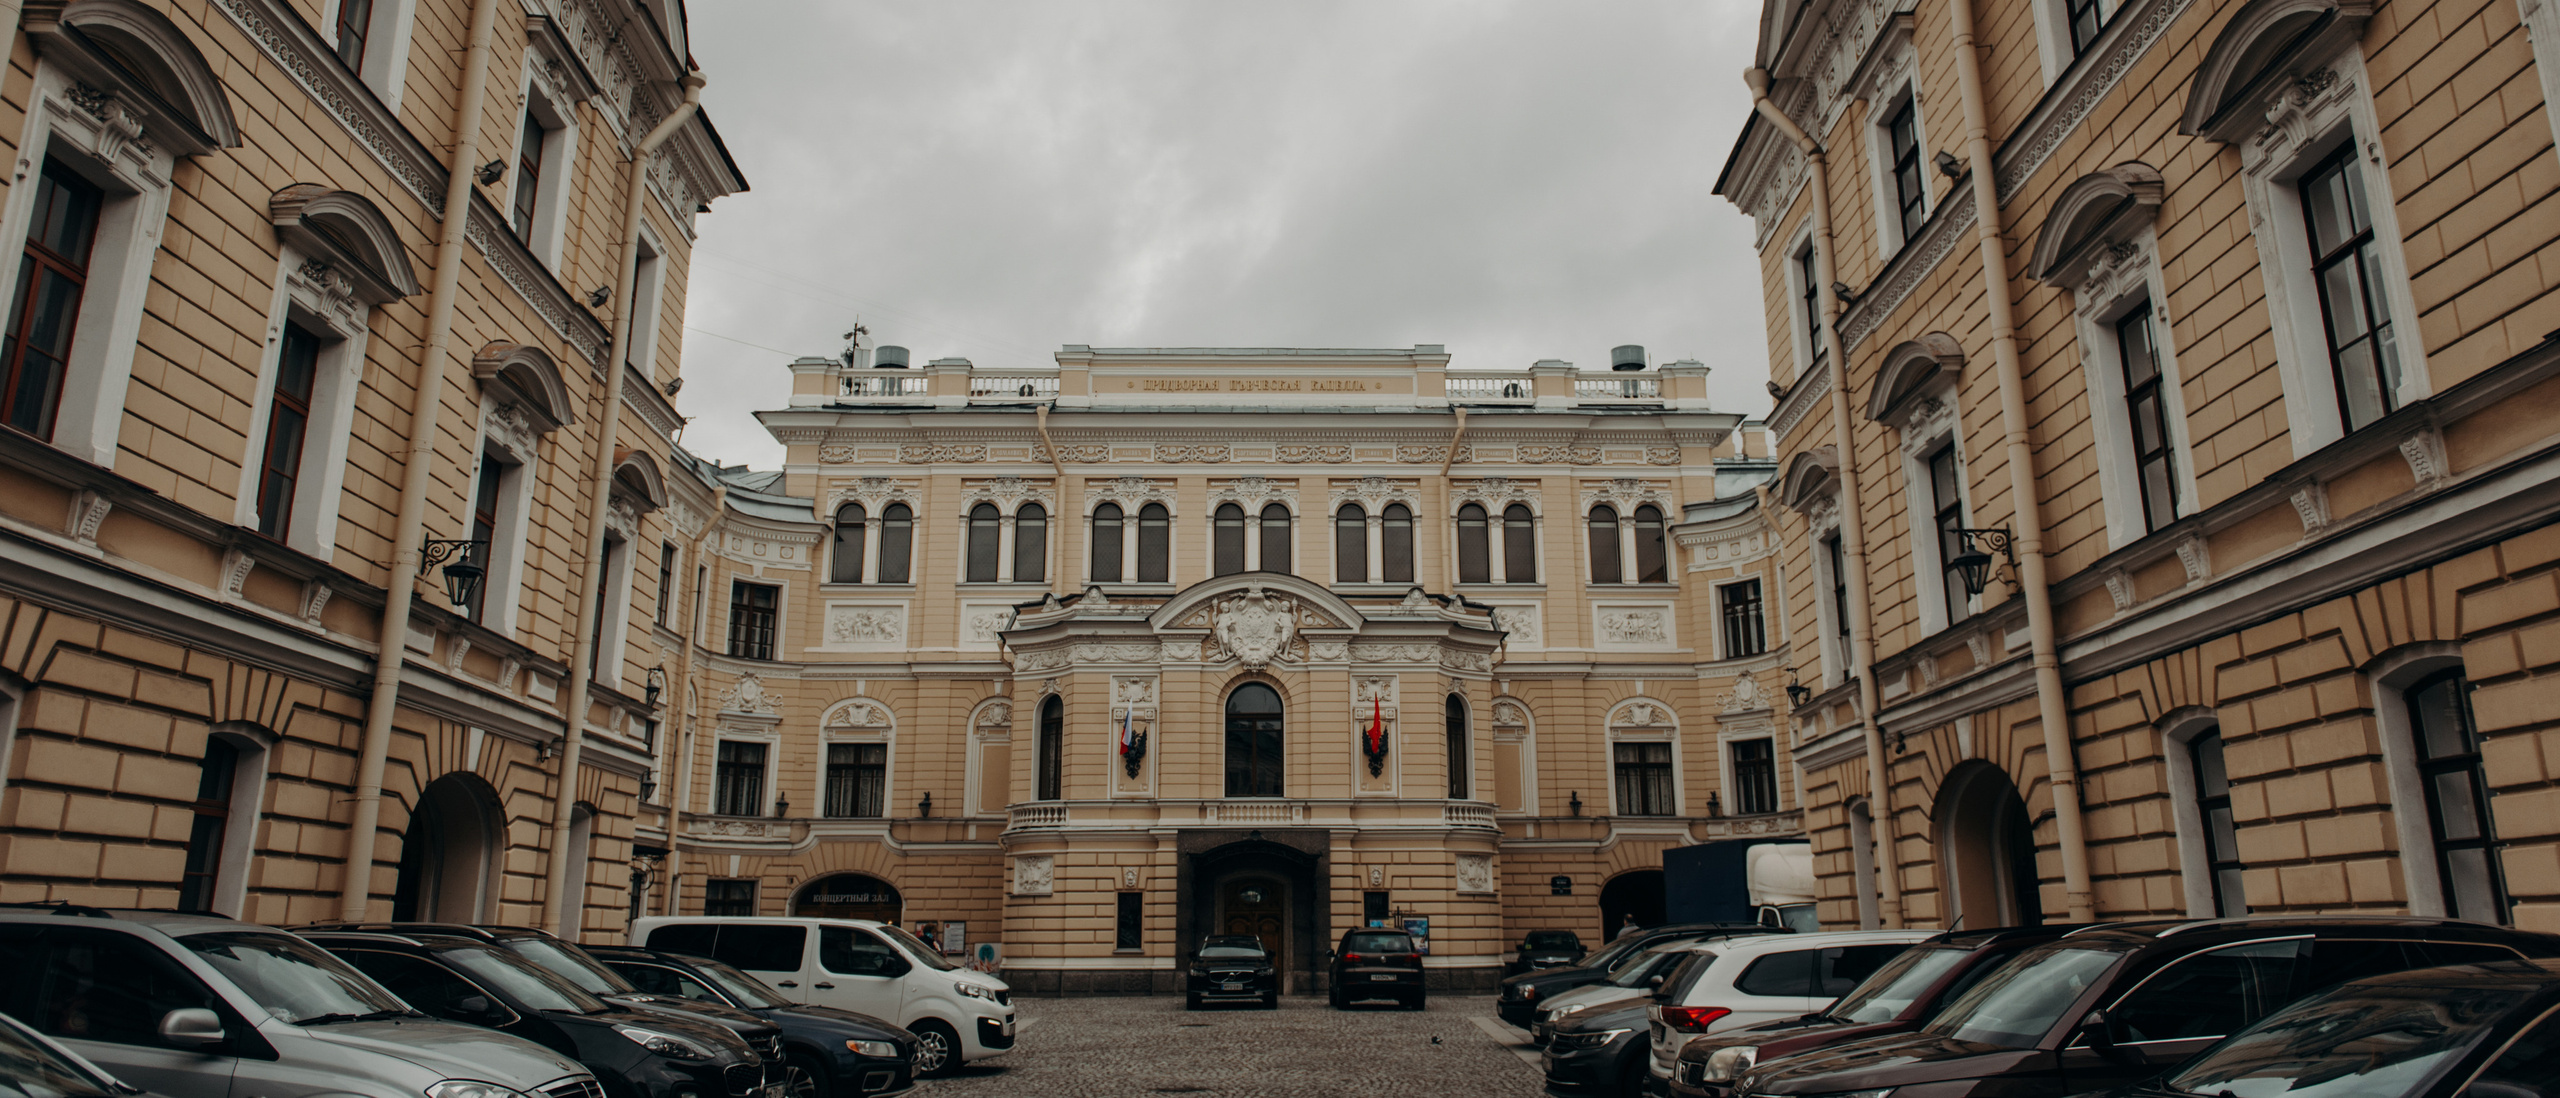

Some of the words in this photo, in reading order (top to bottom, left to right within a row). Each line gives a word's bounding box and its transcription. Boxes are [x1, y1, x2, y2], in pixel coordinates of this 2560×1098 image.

[1143, 379, 1220, 392] ПРИДВОРНАЯ
[1310, 379, 1366, 391] КАПЕЛЛА
[812, 893, 870, 904] КОНЦЕРТНЫЙ
[871, 894, 890, 903] ЗАЛ
